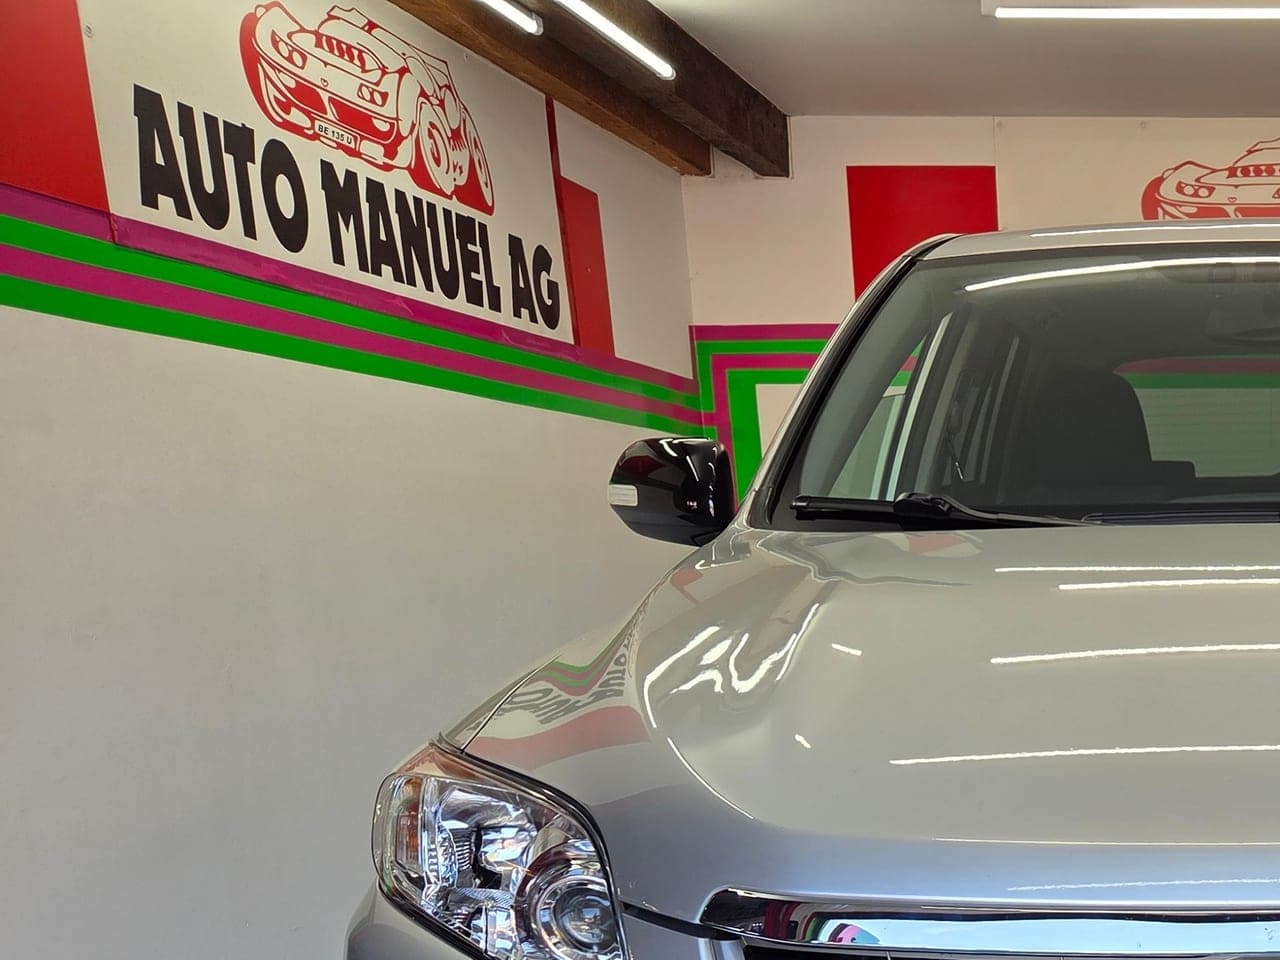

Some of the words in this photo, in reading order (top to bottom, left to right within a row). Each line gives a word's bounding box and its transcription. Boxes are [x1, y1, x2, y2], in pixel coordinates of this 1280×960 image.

[318, 124, 329, 135] BE
[346, 136, 352, 144] U
[133, 83, 309, 254] AUTO
[319, 158, 502, 313] MANUEL
[507, 233, 560, 330] AG
